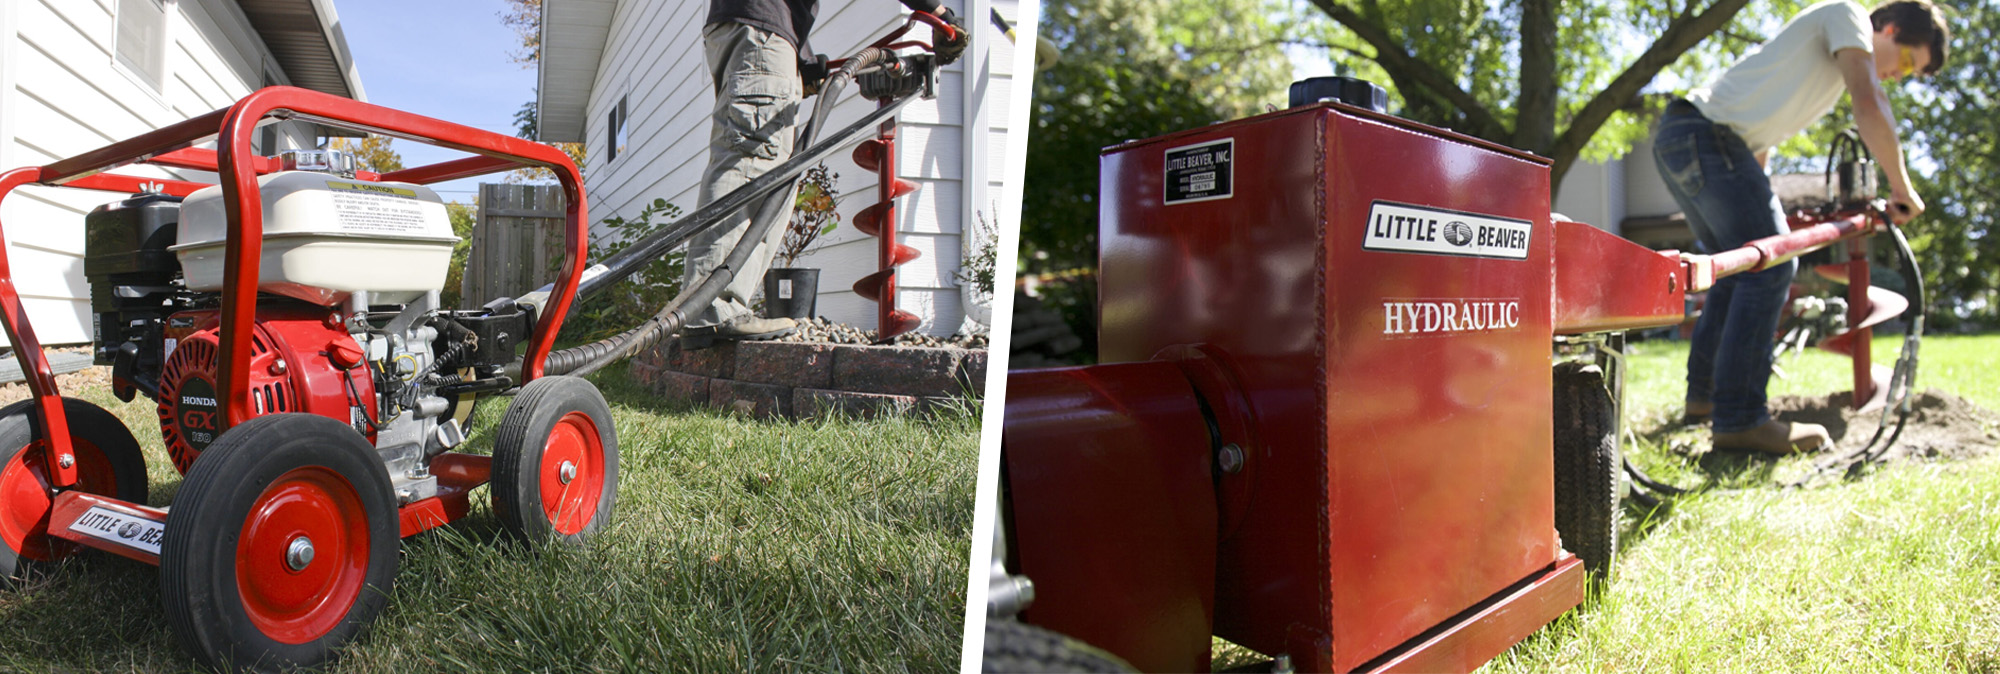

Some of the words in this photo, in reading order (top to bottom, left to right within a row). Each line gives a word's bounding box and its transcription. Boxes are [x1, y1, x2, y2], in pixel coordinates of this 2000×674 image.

[1167, 157, 1186, 171] LITTLE
[1187, 153, 1214, 168] BEAVER,
[1215, 150, 1230, 163] INC.
[362, 184, 395, 194] CAUTION
[1374, 213, 1437, 242] LITTLE
[1477, 225, 1526, 250] BEAVER
[1383, 301, 1519, 334] HYDRAULIC
[182, 396, 217, 407] HONDA
[183, 410, 216, 430] GX
[191, 431, 213, 443] 160
[78, 511, 122, 533] LITTLE
